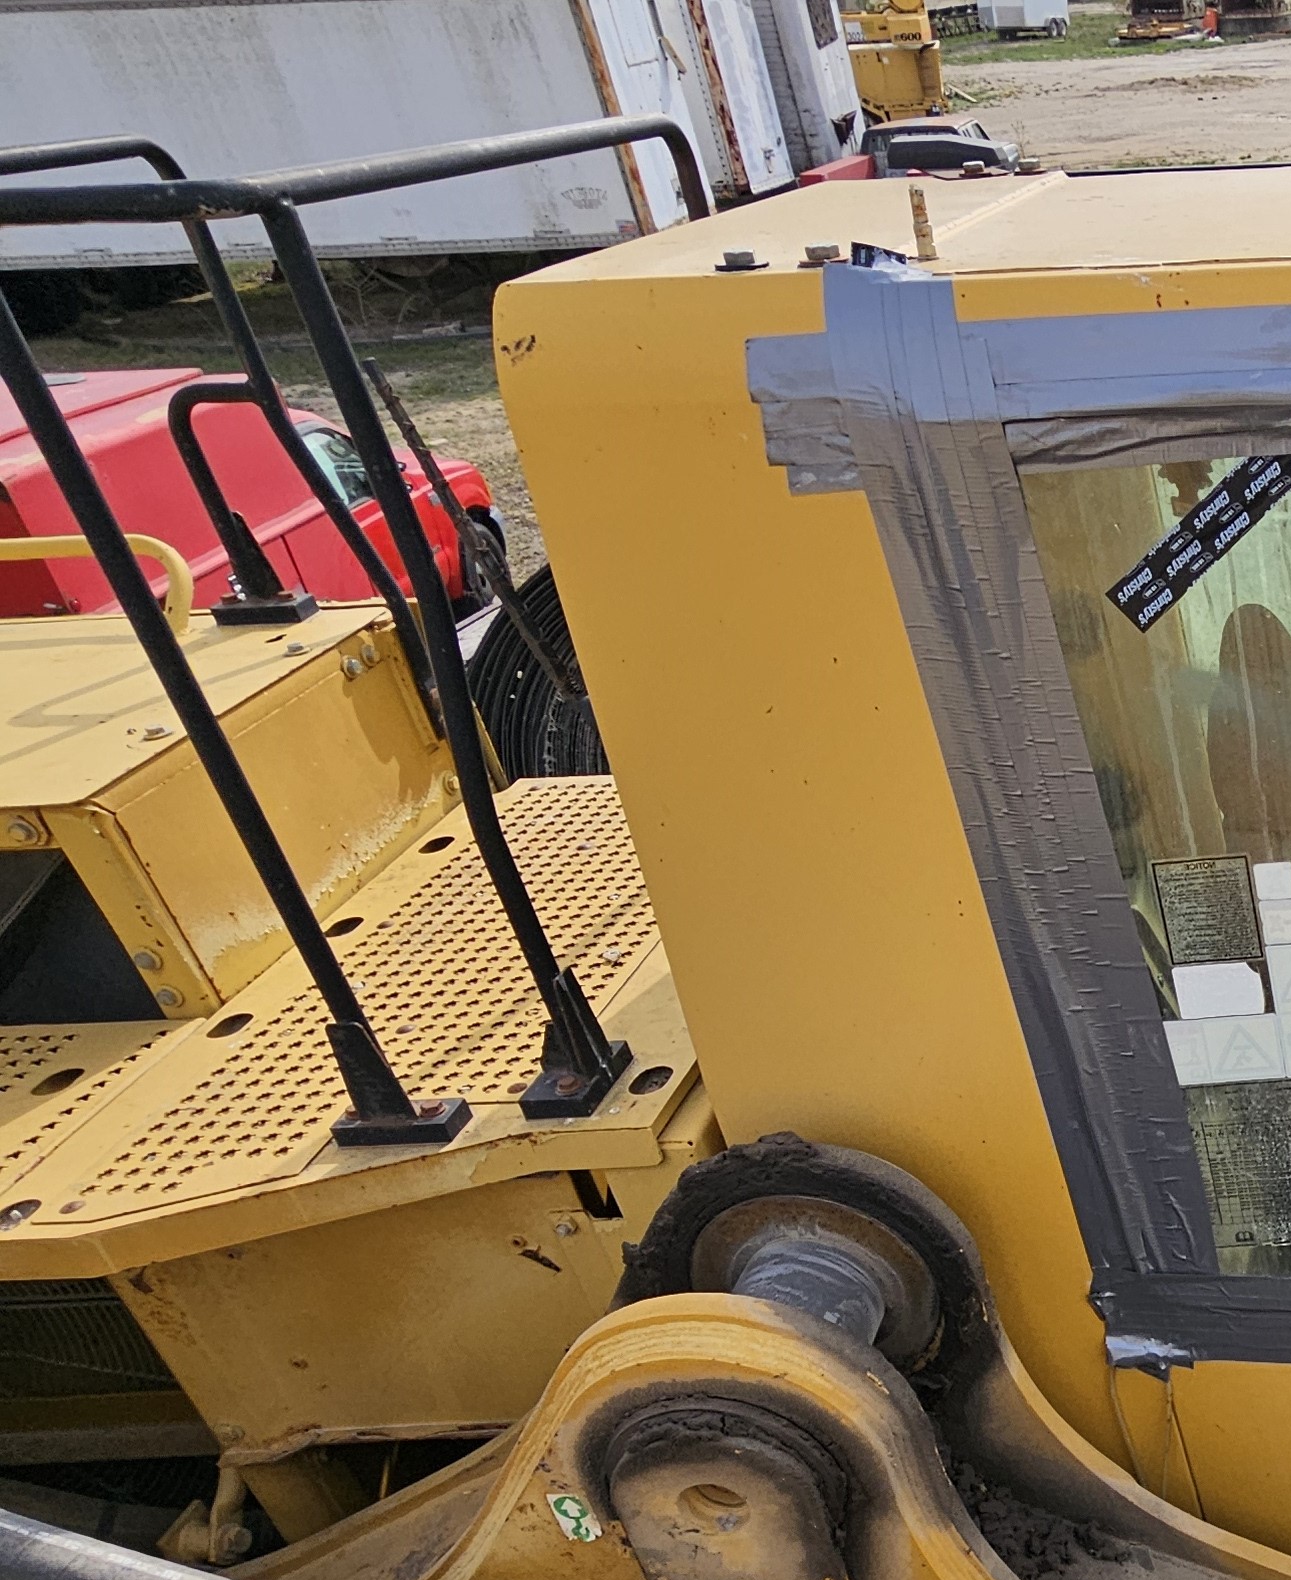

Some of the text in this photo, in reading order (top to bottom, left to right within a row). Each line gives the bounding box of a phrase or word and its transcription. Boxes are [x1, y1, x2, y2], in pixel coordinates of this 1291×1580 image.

[1244, 461, 1281, 500] Christy's
[1193, 490, 1230, 529] Christy's
[1214, 511, 1250, 550] Christy's
[1166, 539, 1202, 577] Christy's
[1117, 567, 1153, 603] Christy's
[1138, 588, 1173, 624] Christy's
